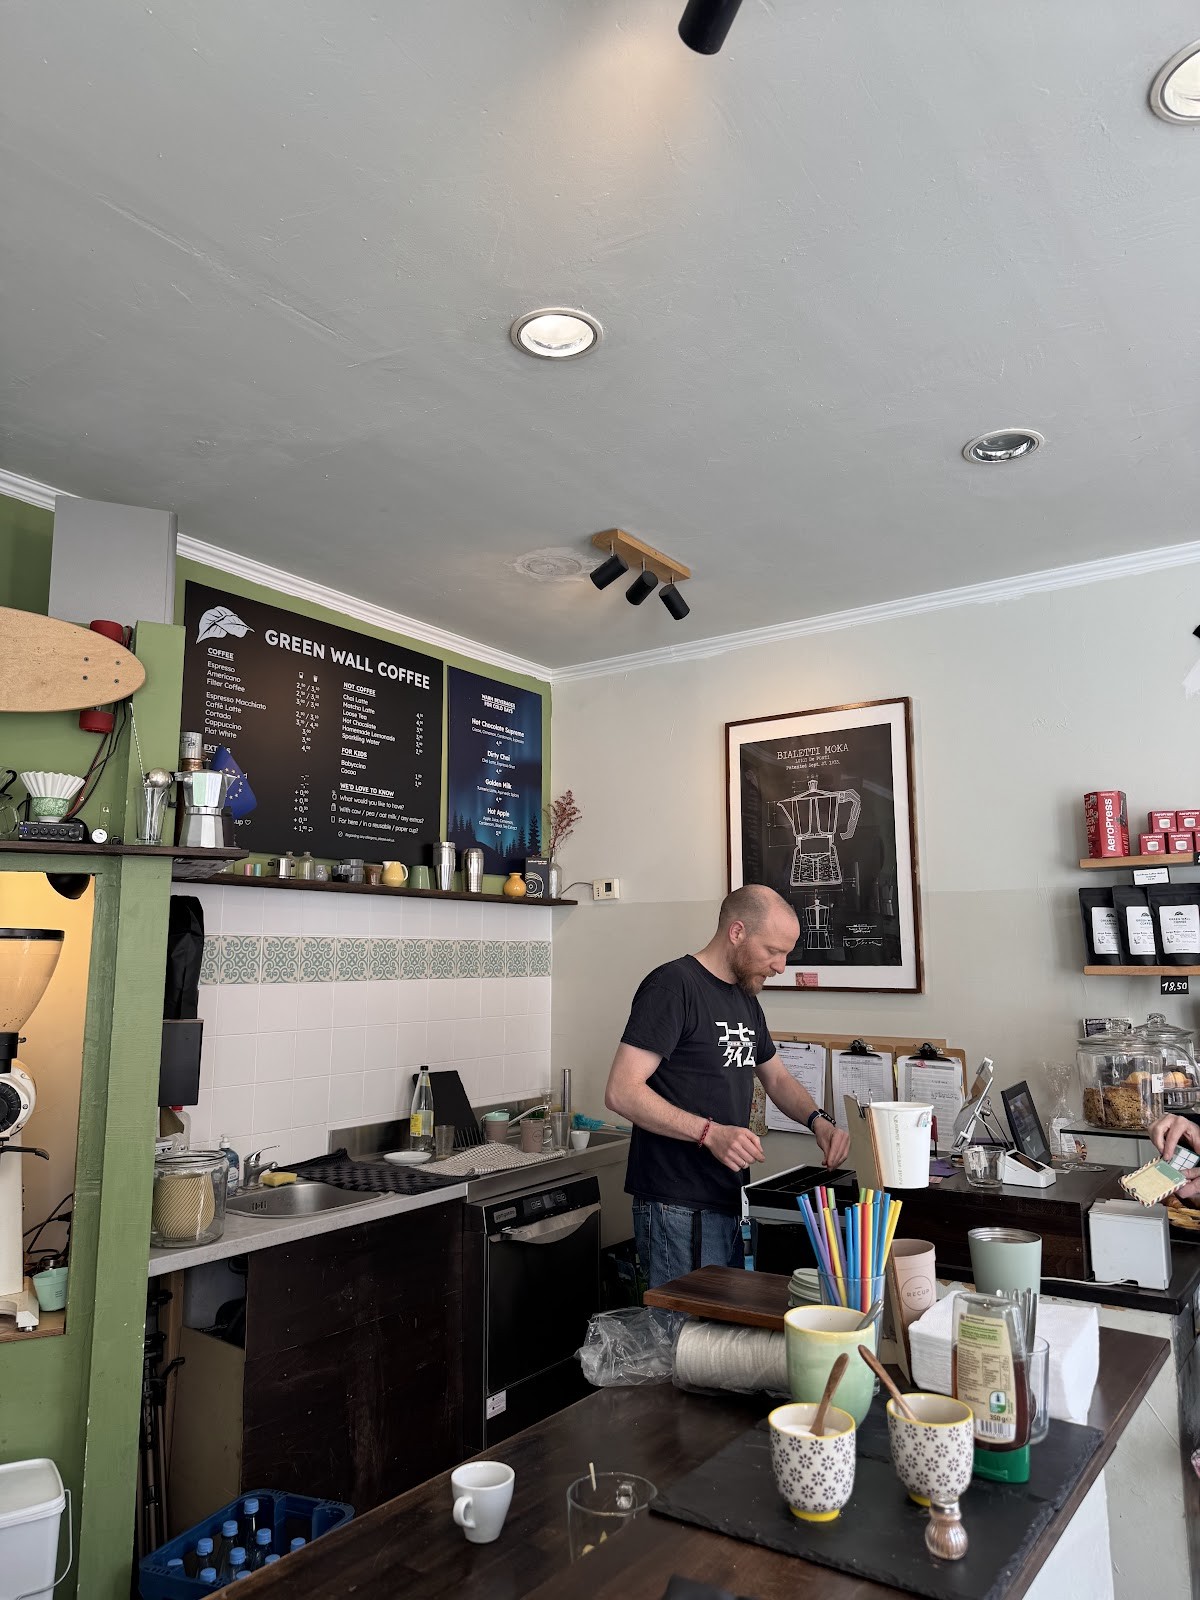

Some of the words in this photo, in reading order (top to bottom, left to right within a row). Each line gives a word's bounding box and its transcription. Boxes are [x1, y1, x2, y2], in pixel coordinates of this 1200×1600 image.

[207, 647, 234, 660] COFFEE
[265, 629, 325, 660] GREEN
[330, 646, 374, 674] WALL
[378, 662, 430, 690] COFFEE
[207, 661, 236, 672] Espresso
[206, 670, 241, 683] Americano
[206, 678, 223, 687] Filter
[224, 682, 246, 692] Coffee
[356, 685, 376, 696] COFFEE
[206, 692, 234, 703] Espresso
[235, 698, 267, 710] Macchiato
[206, 700, 223, 710] Caffè
[225, 704, 242, 714] Latte
[355, 697, 368, 706] Latte
[343, 702, 361, 712] Matcha
[362, 704, 375, 714] Latte
[343, 710, 357, 718] Loose
[205, 709, 232, 720] Cortado
[204, 718, 242, 731] Cappuccino
[353, 719, 376, 730] Chocolate
[481, 721, 504, 732] Chocolate
[505, 727, 524, 737] Supreme
[204, 727, 217, 736] Flat
[219, 730, 237, 739] White
[342, 725, 370, 736] Homemade
[371, 731, 396, 742] Lemonade
[342, 733, 365, 744] Sparkling
[366, 738, 380, 746] Water
[204, 744, 231, 754] EXTS
[487, 750, 499, 760] Dirty
[777, 747, 820, 760] BIALETTI
[824, 743, 849, 754] MOKA
[341, 760, 366, 770] Babyccino
[485, 779, 502, 788] Golden
[497, 810, 510, 818] Apple
[1162, 982, 1187, 991] 18,50
[722, 1046, 756, 1067] タイム
[907, 1289, 929, 1297] RECUP
